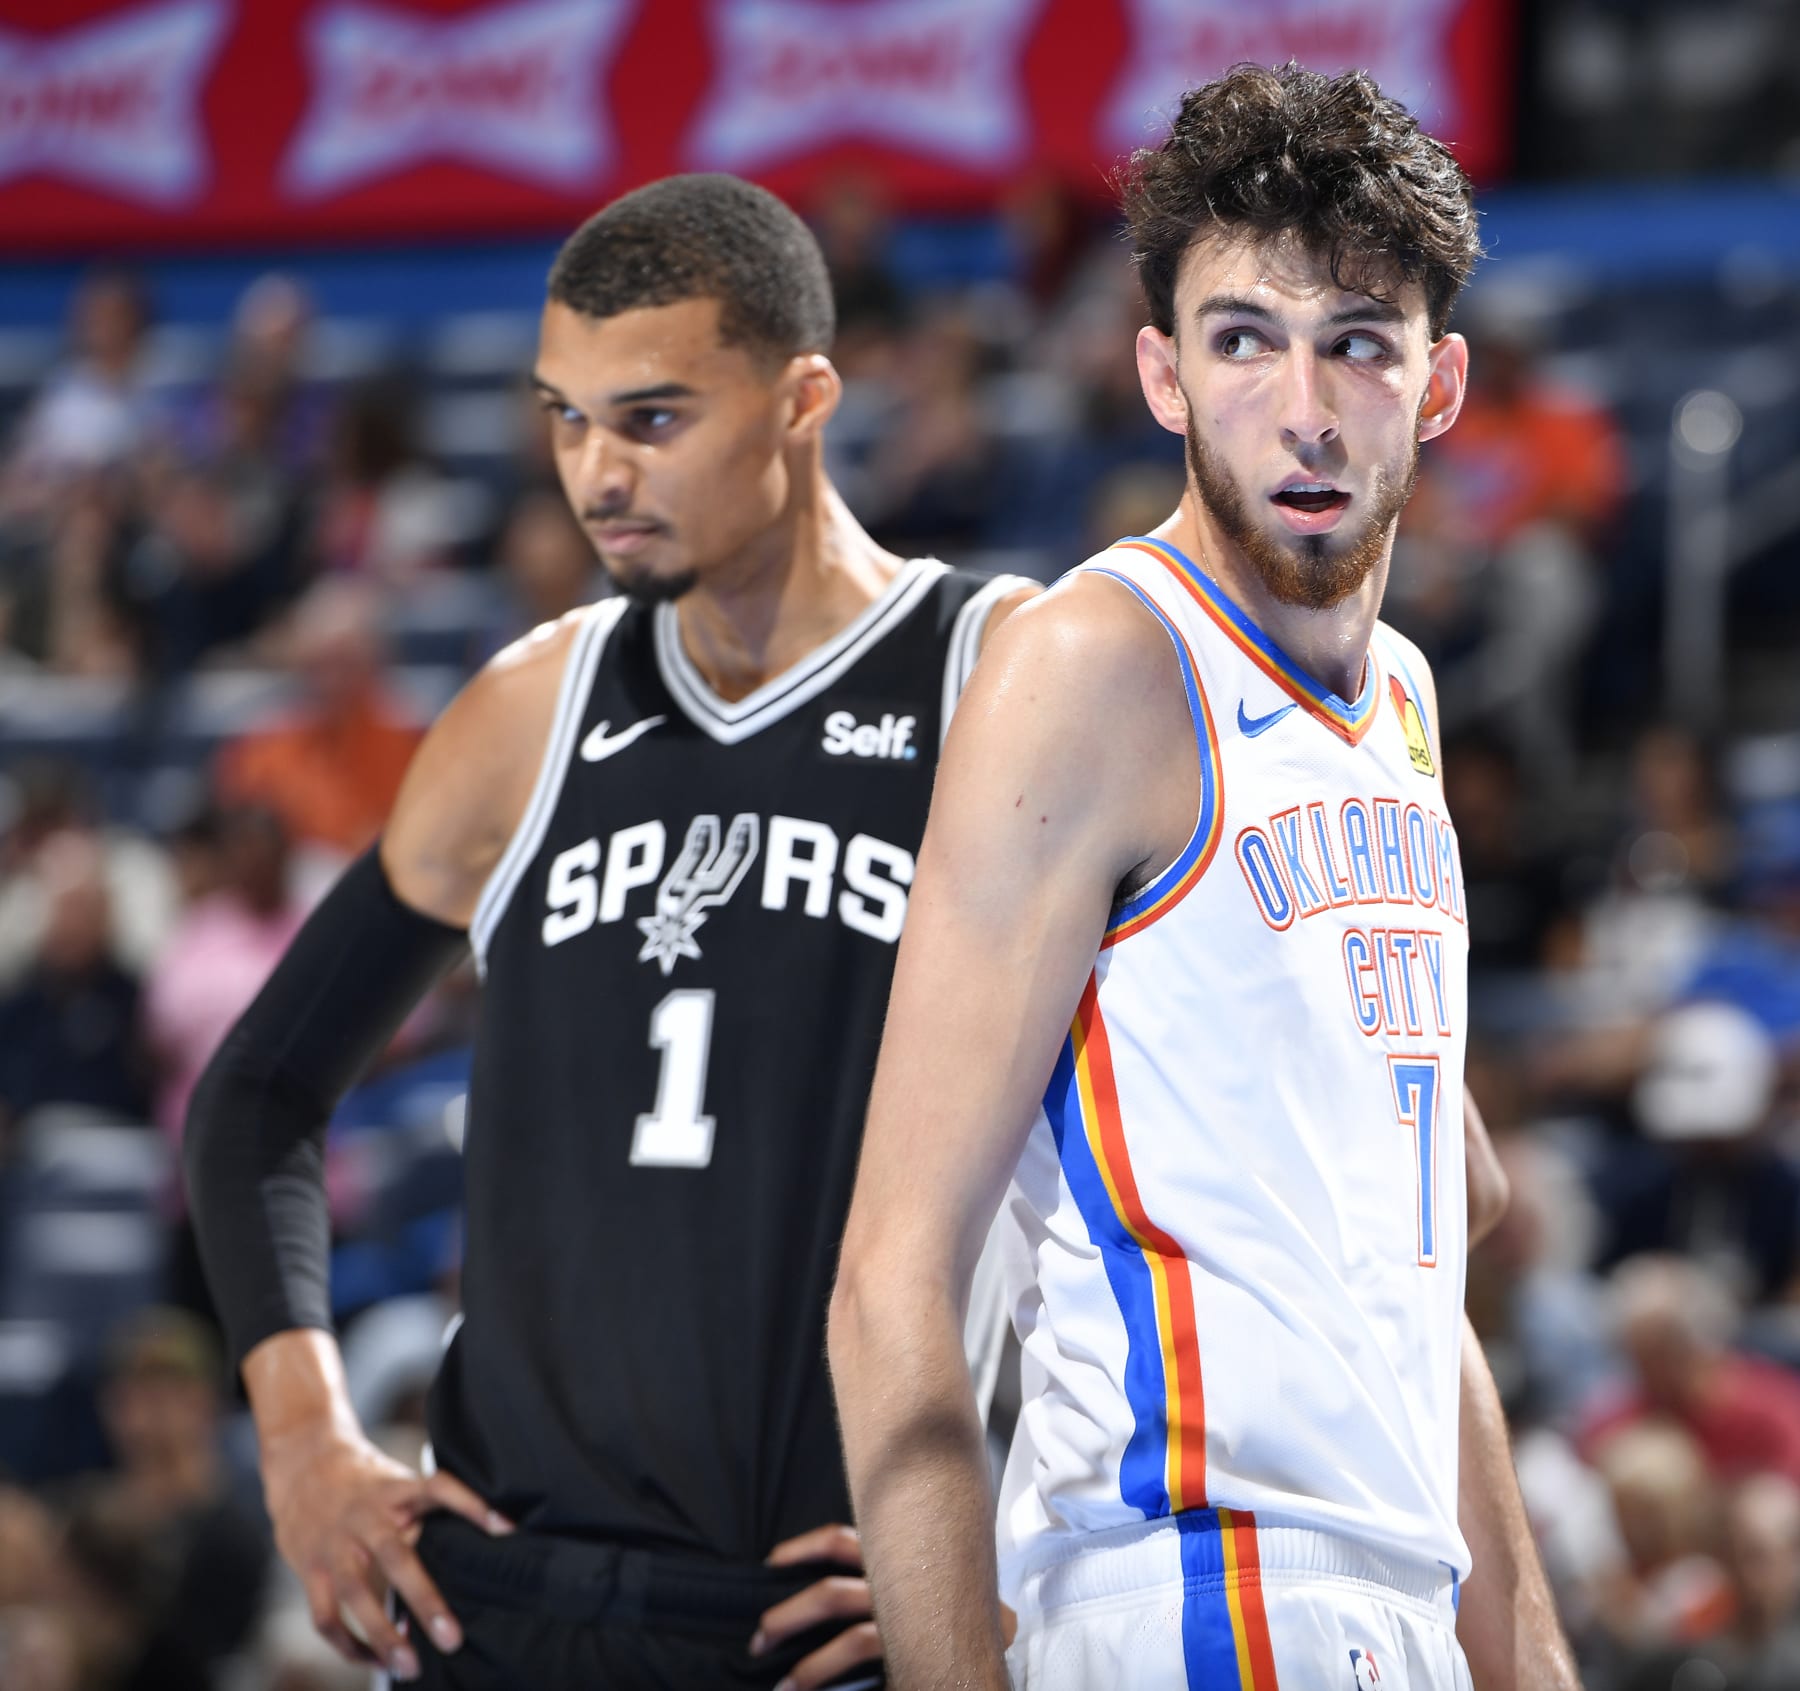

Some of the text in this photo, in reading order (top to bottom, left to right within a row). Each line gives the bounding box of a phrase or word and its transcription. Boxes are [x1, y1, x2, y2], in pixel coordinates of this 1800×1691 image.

[821, 710, 918, 761] Self.
[542, 812, 916, 947] SPURS
[1234, 797, 1466, 932] OKLAHOM
[1342, 928, 1451, 1037] CITY
[628, 988, 716, 1168] 1
[1387, 1053, 1440, 1268] 7
